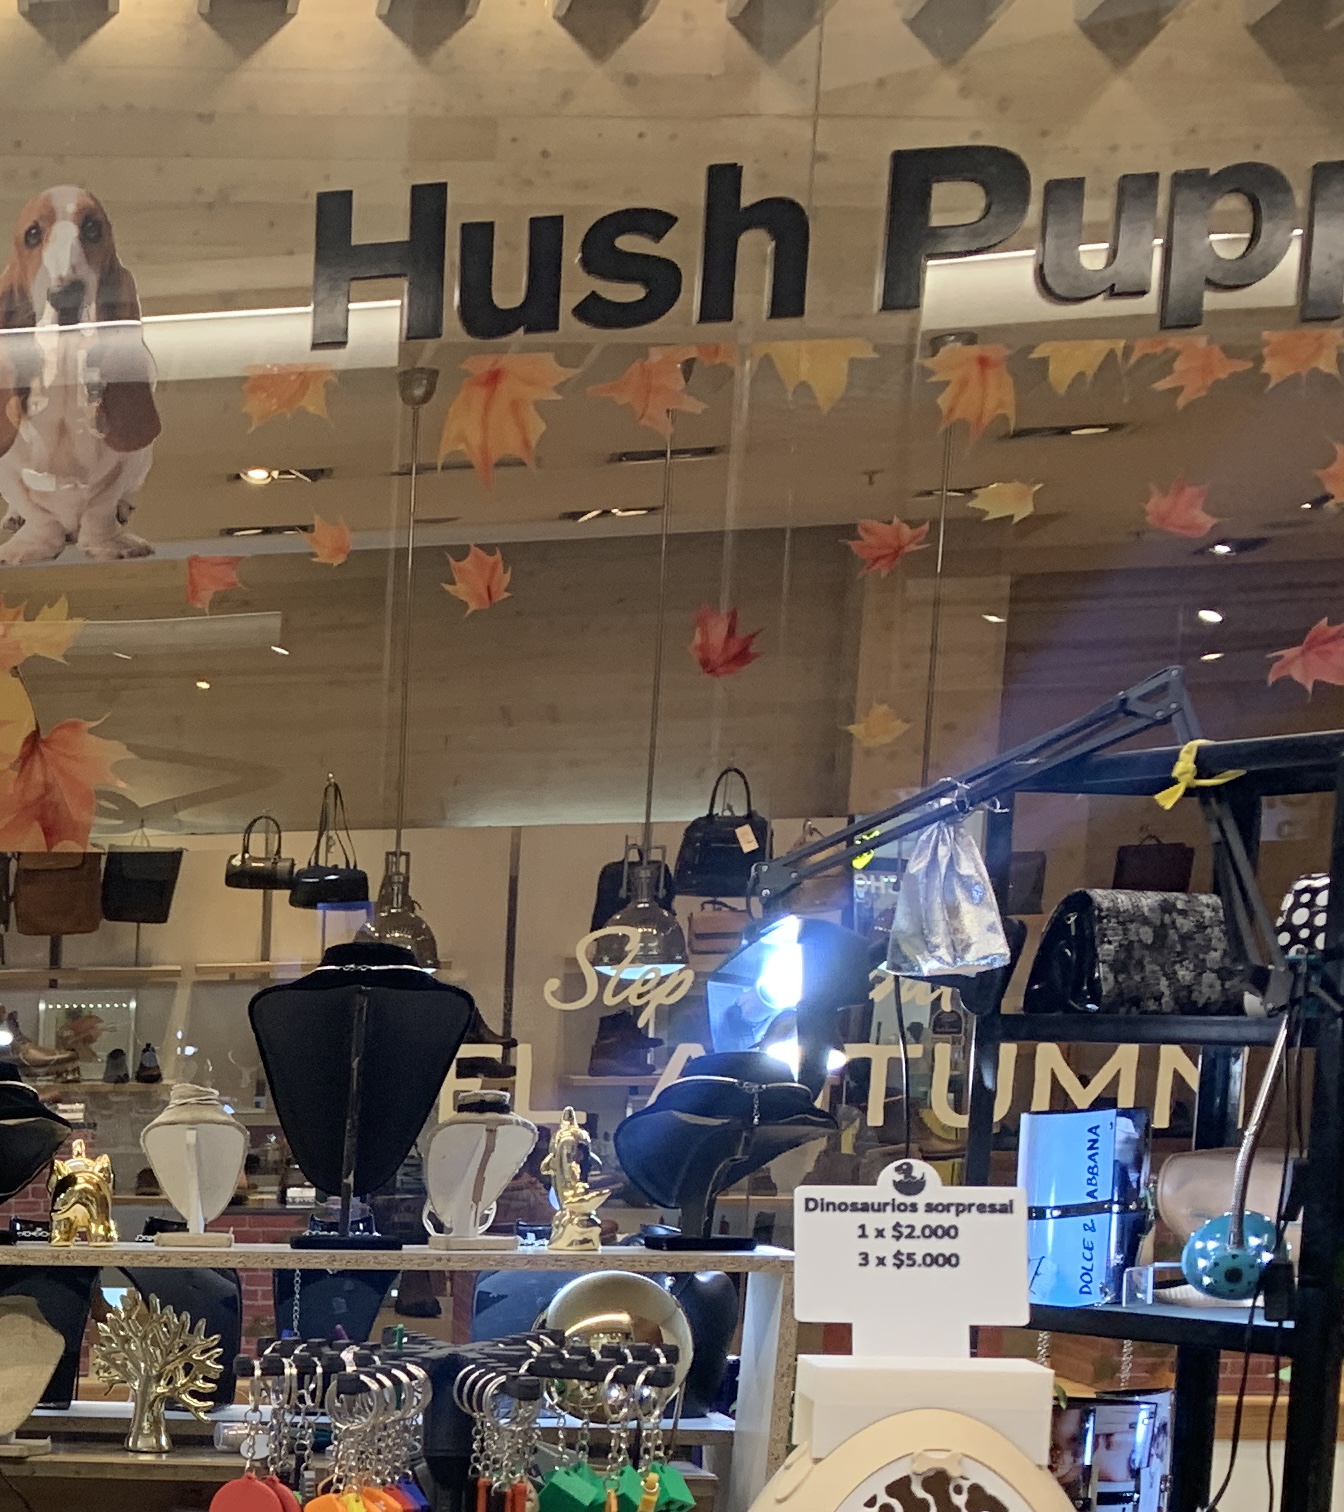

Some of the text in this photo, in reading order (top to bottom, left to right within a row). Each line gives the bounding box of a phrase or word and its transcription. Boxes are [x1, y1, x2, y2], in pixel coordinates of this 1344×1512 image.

[310, 143, 1344, 349] Hush Pup
[543, 925, 696, 1029] Step
[804, 1197, 1014, 1217] Dinosaurios sorpresa!
[857, 1222, 959, 1242] 1 x $2.000
[1079, 1124, 1101, 1295] DOLCE & ABBANA
[858, 1251, 960, 1270] 3 x $5.000
